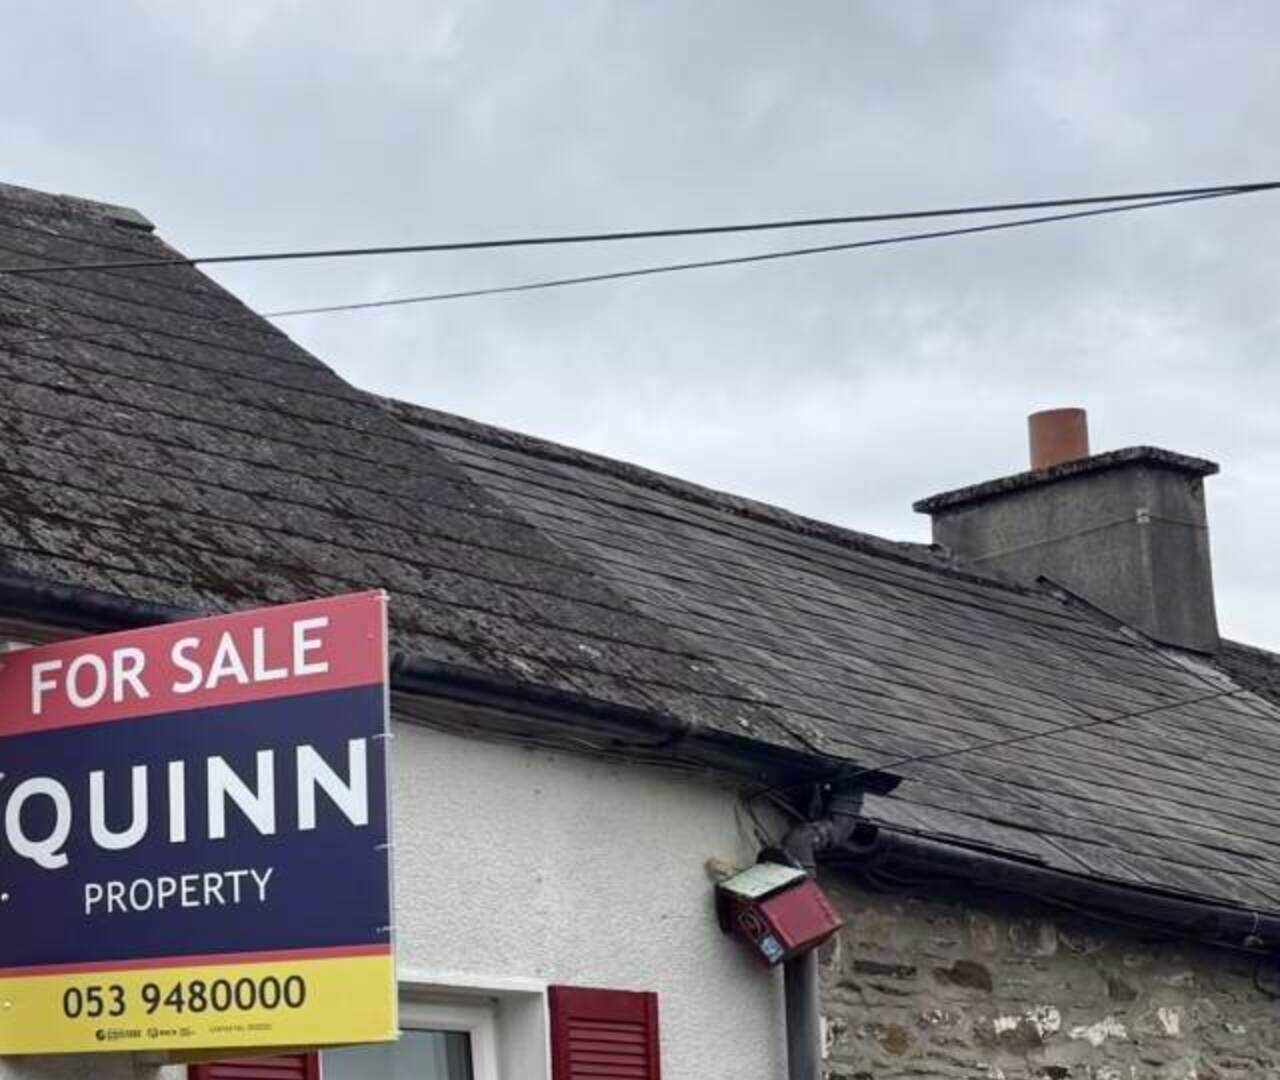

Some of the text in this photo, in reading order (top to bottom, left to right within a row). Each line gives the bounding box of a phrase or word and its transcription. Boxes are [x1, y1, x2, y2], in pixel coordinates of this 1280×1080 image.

[31, 616, 329, 714] FOR SALE
[5, 738, 368, 869] QUINN
[84, 868, 273, 915] PROPERTY
[62, 975, 307, 1018] 053 9480000
